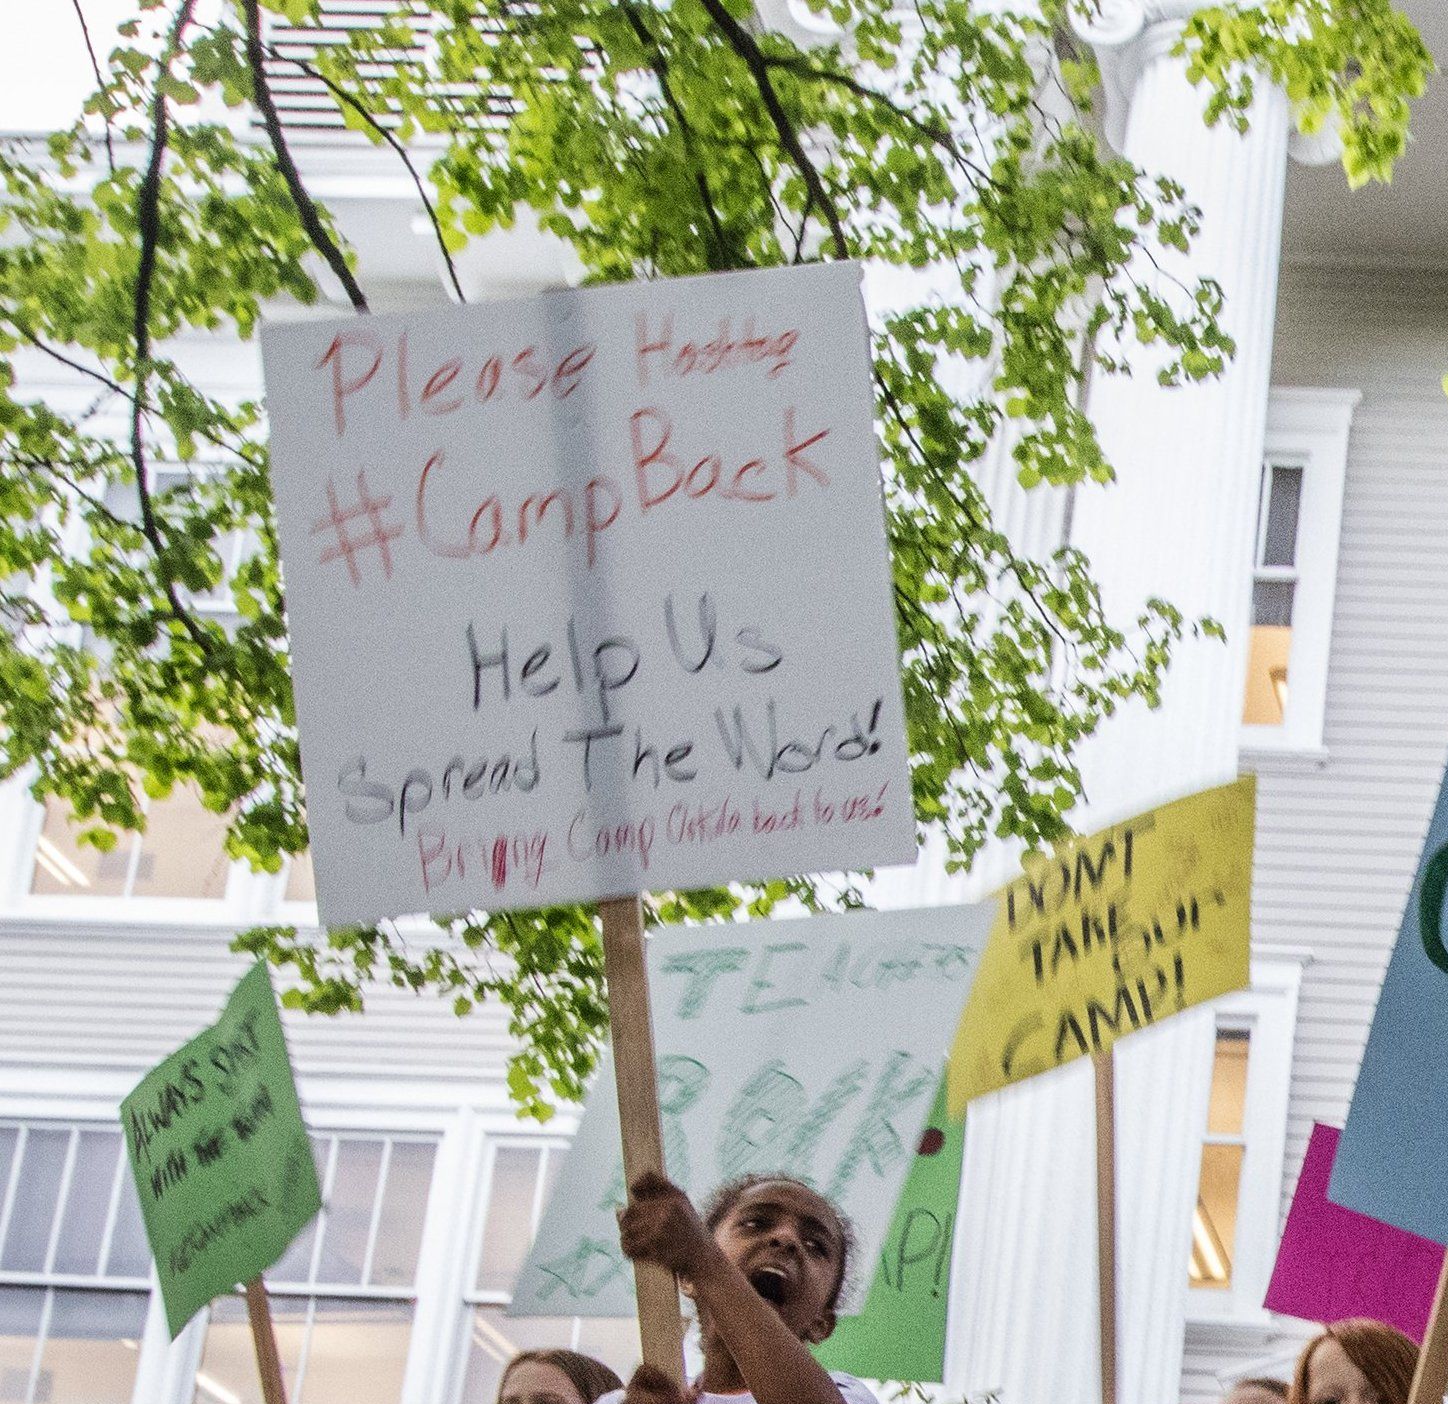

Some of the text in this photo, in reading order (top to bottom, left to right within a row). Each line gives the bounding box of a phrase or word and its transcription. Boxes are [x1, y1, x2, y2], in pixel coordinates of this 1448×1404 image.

[316, 330, 597, 436] Please
[464, 590, 785, 722] Help Us
[337, 699, 883, 837] Spread The Word!
